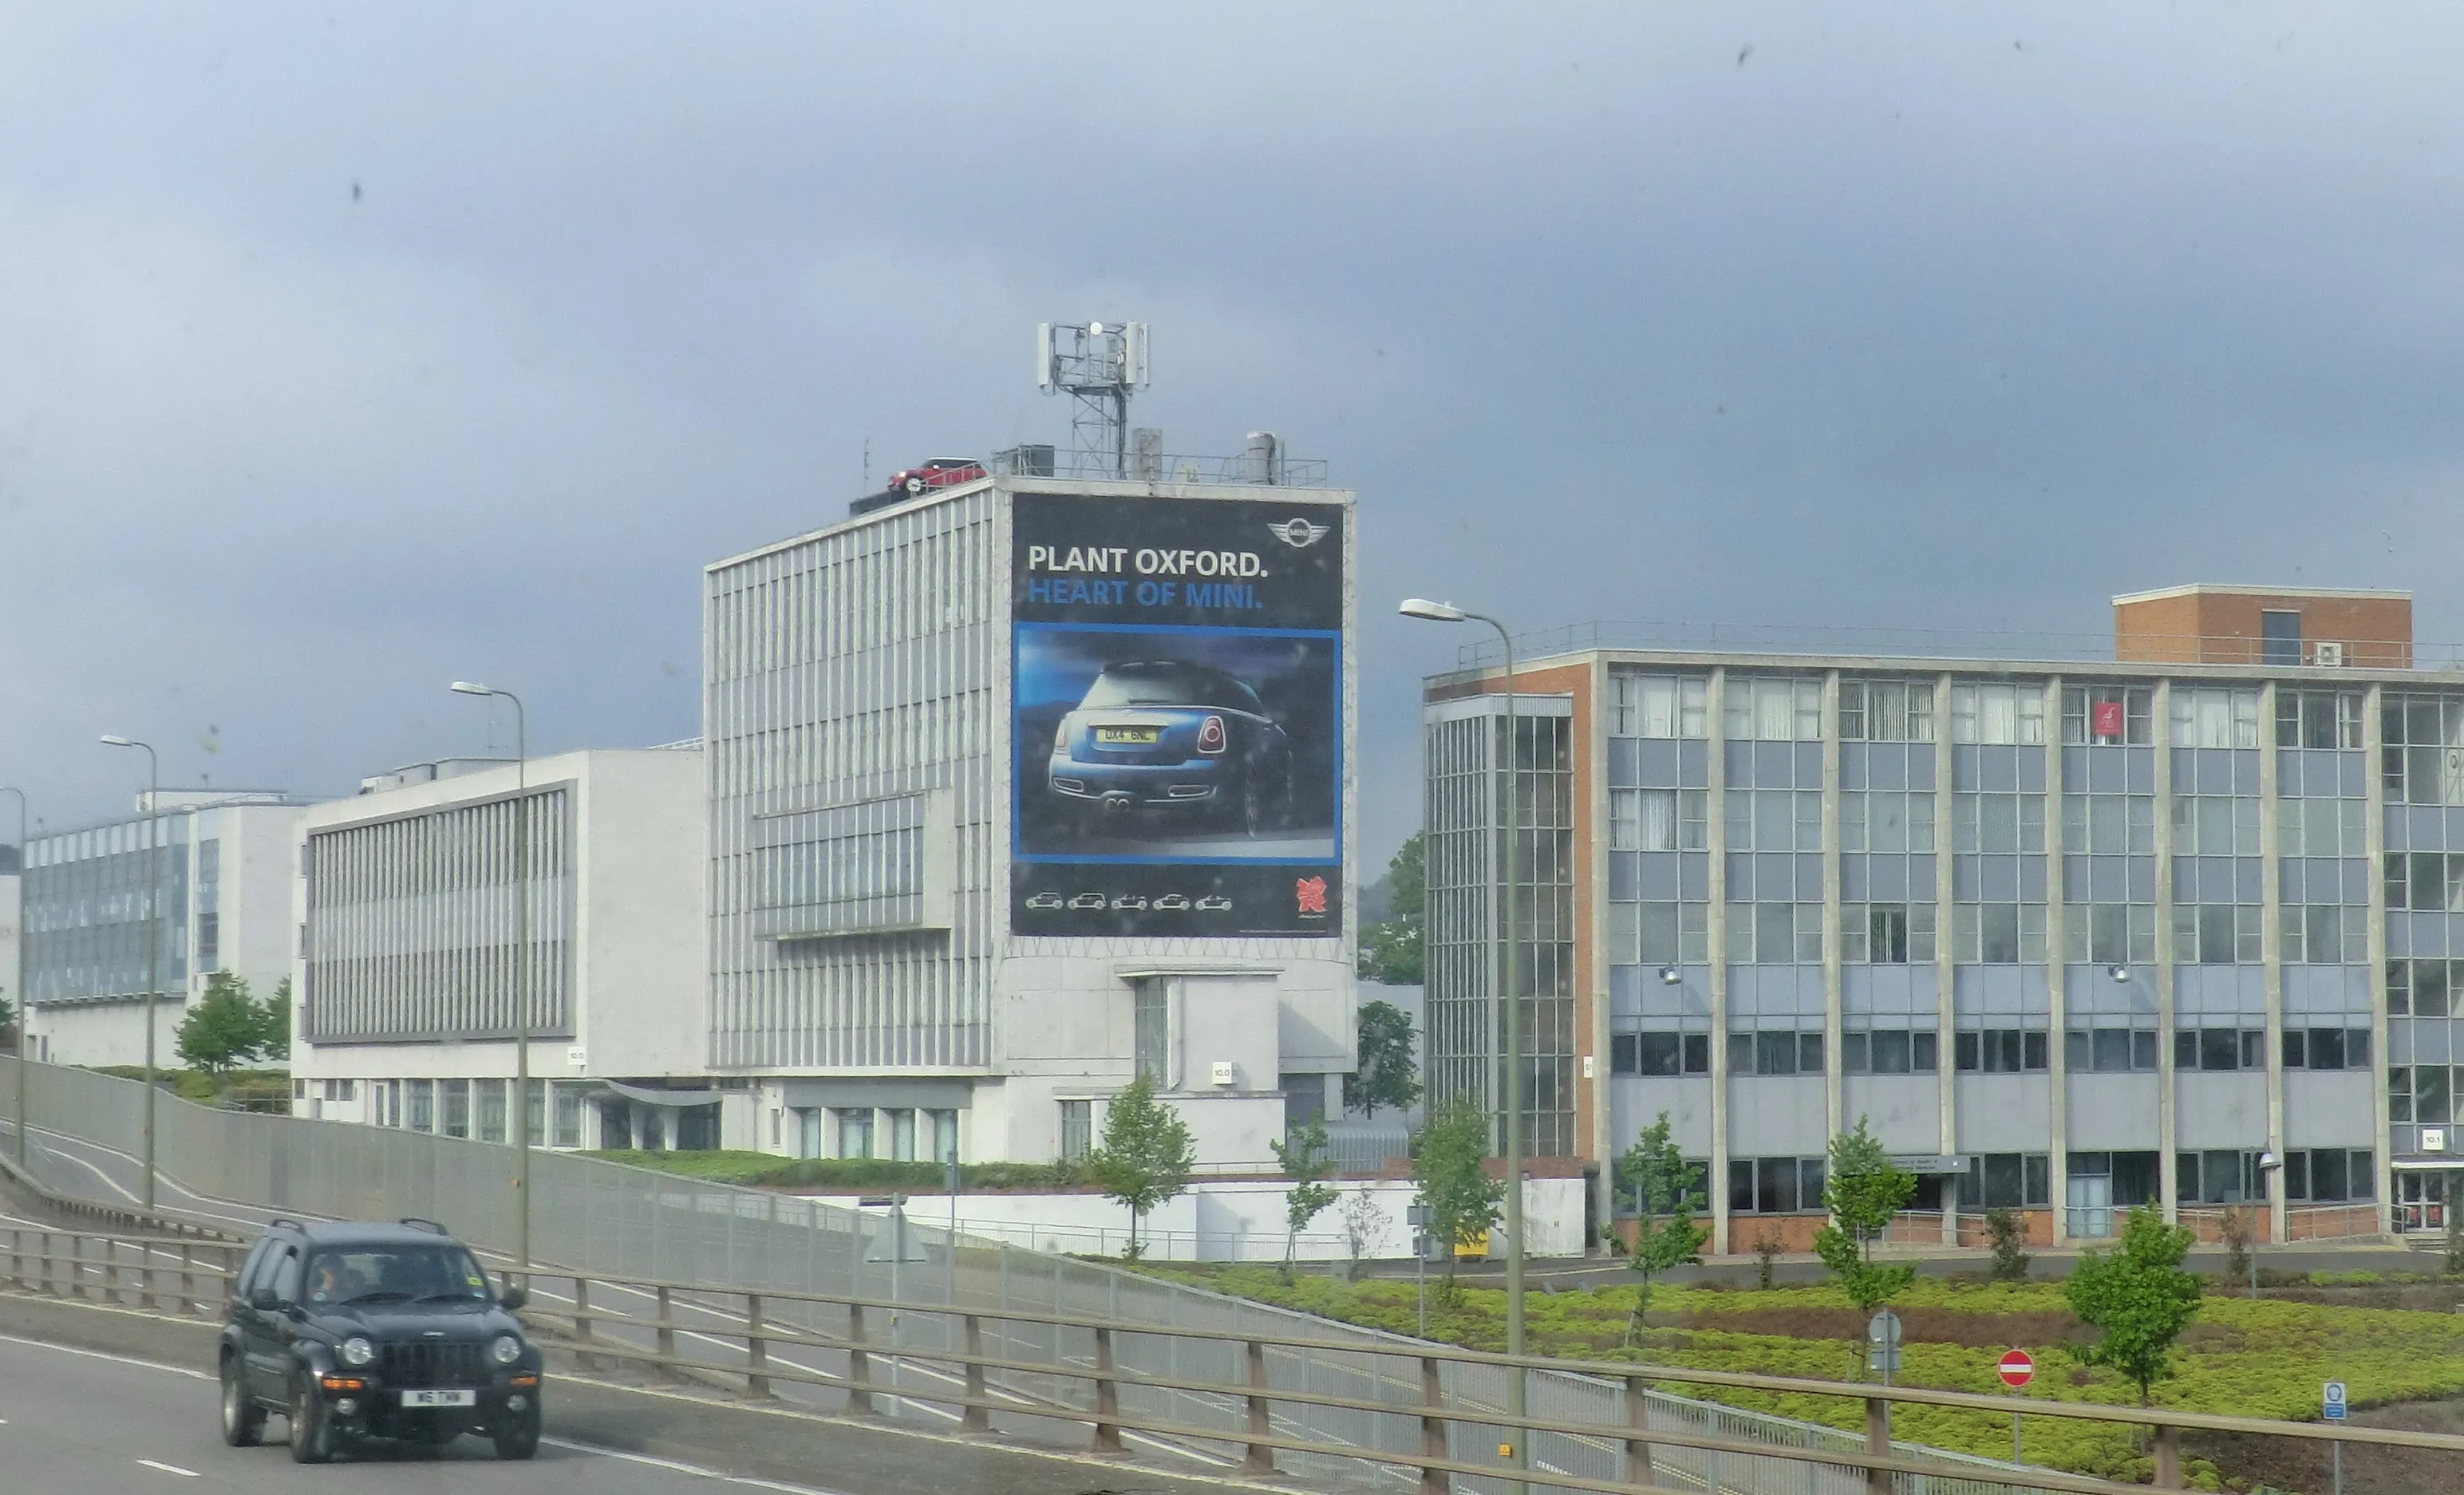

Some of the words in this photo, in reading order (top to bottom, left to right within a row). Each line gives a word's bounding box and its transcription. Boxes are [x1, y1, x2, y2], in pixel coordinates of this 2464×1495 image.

[1029, 546, 1127, 573] PLANT
[1135, 549, 1268, 578] OXFORD.
[1029, 578, 1128, 605] HEART
[1136, 581, 1177, 606] OF
[1186, 582, 1263, 609] MINI.
